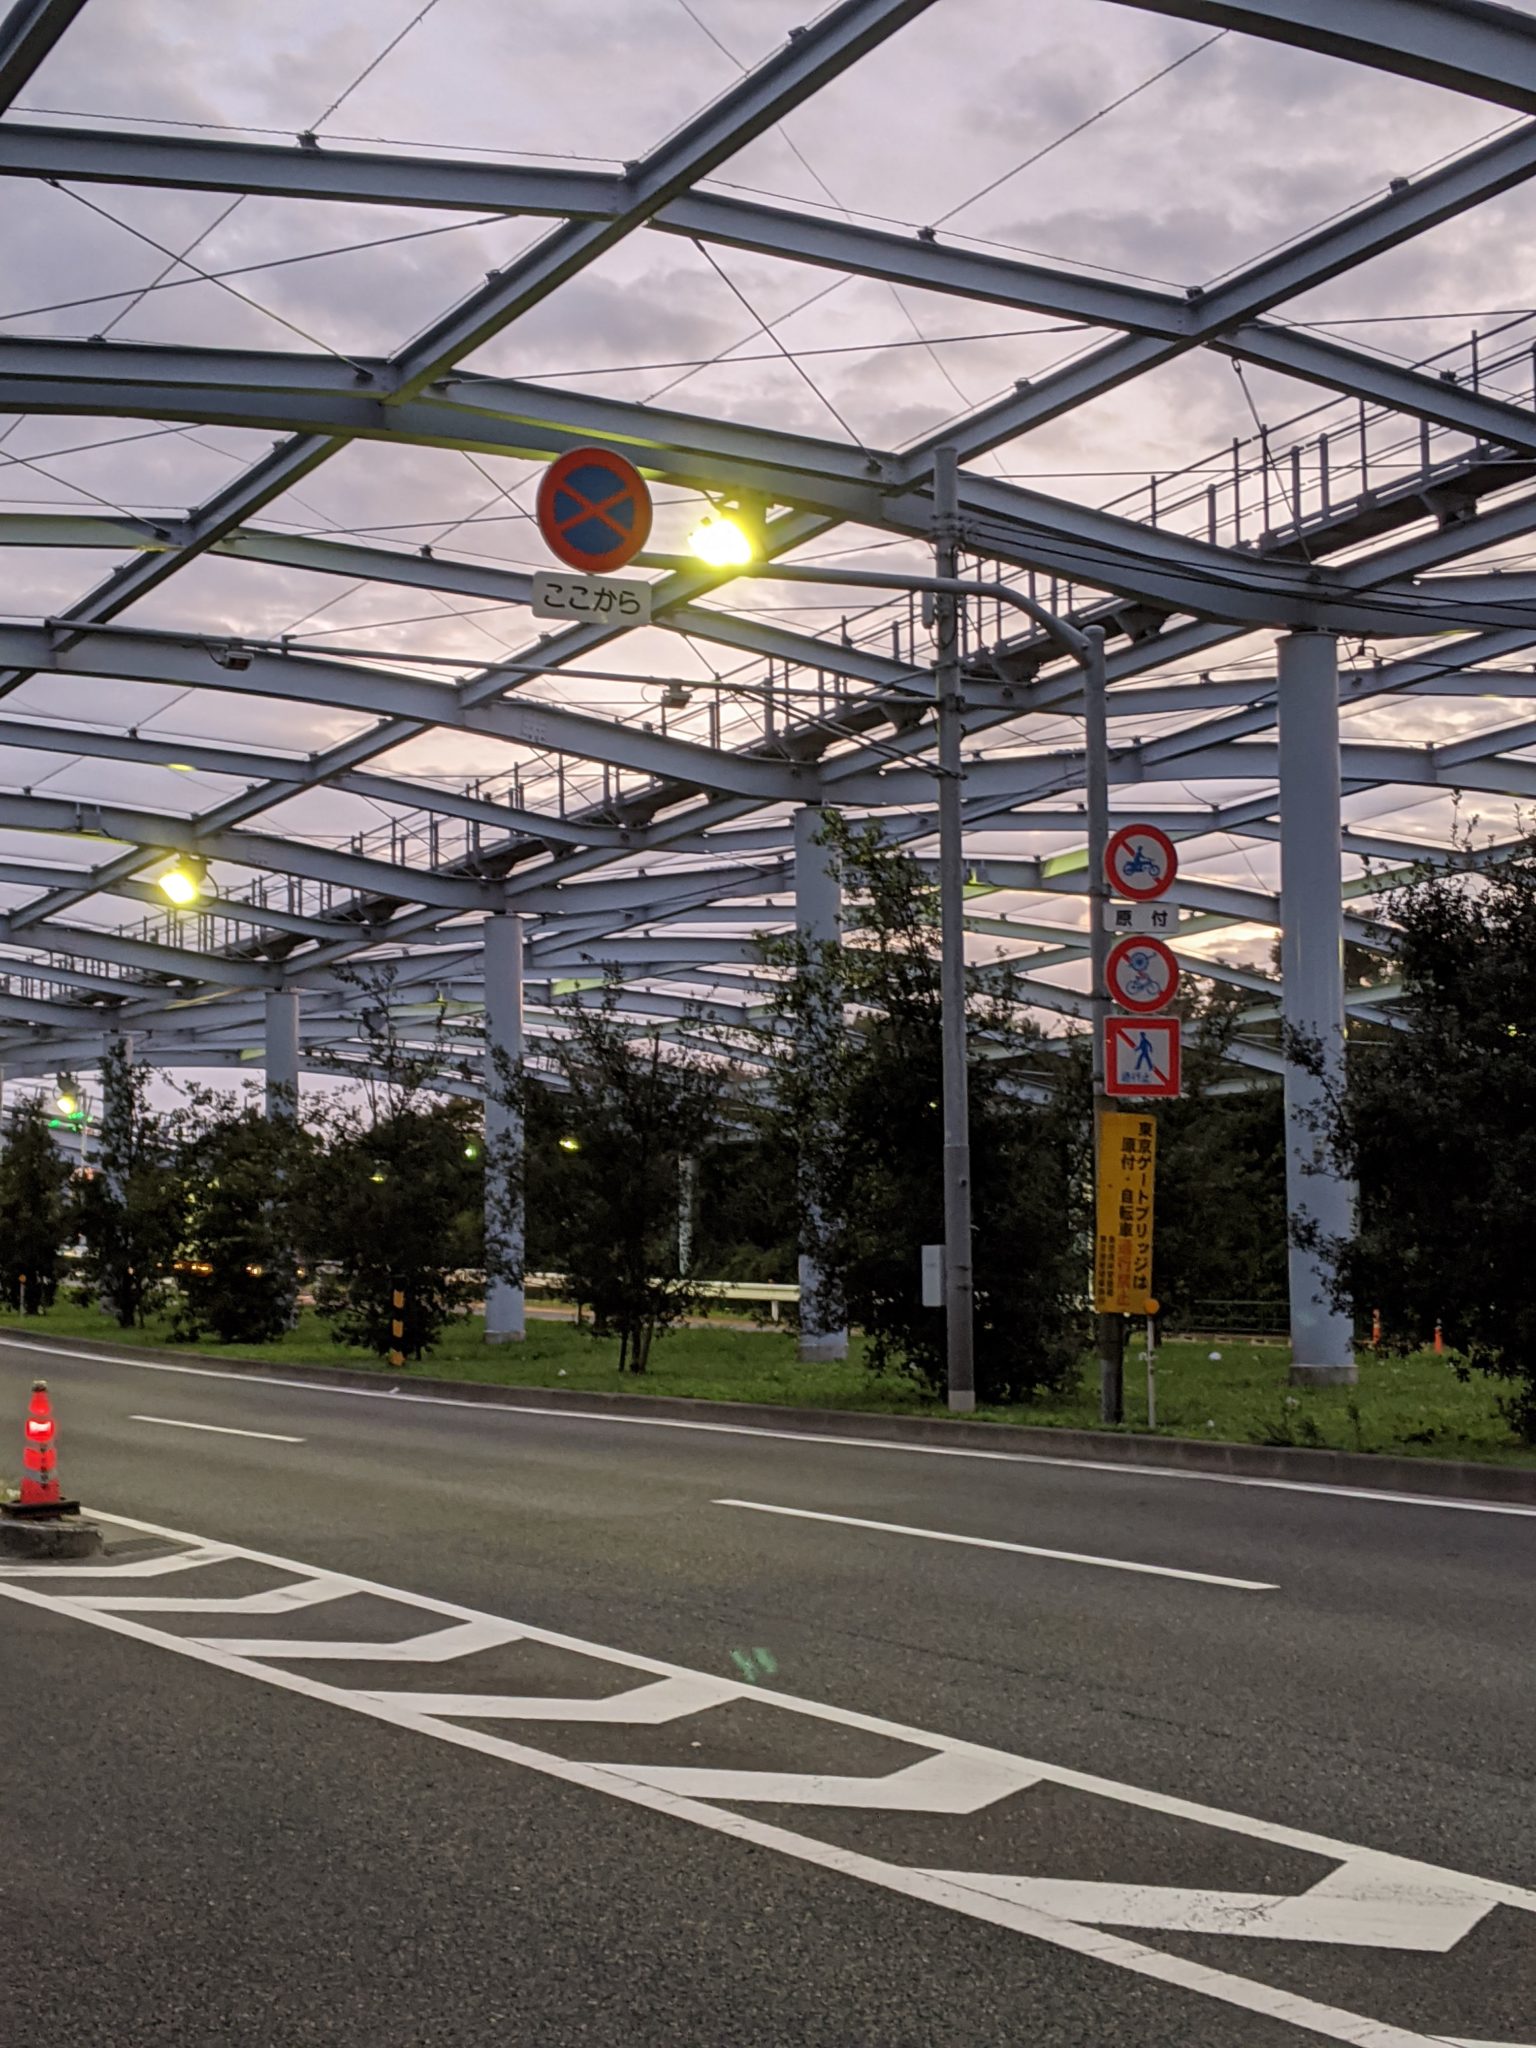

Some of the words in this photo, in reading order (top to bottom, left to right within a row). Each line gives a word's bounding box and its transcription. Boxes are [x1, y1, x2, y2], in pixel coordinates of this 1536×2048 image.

[544, 582, 641, 615] ここから
[1115, 910, 1168, 927] 原付
[1133, 1122, 1153, 1290] 東京ゲートブリッジは
